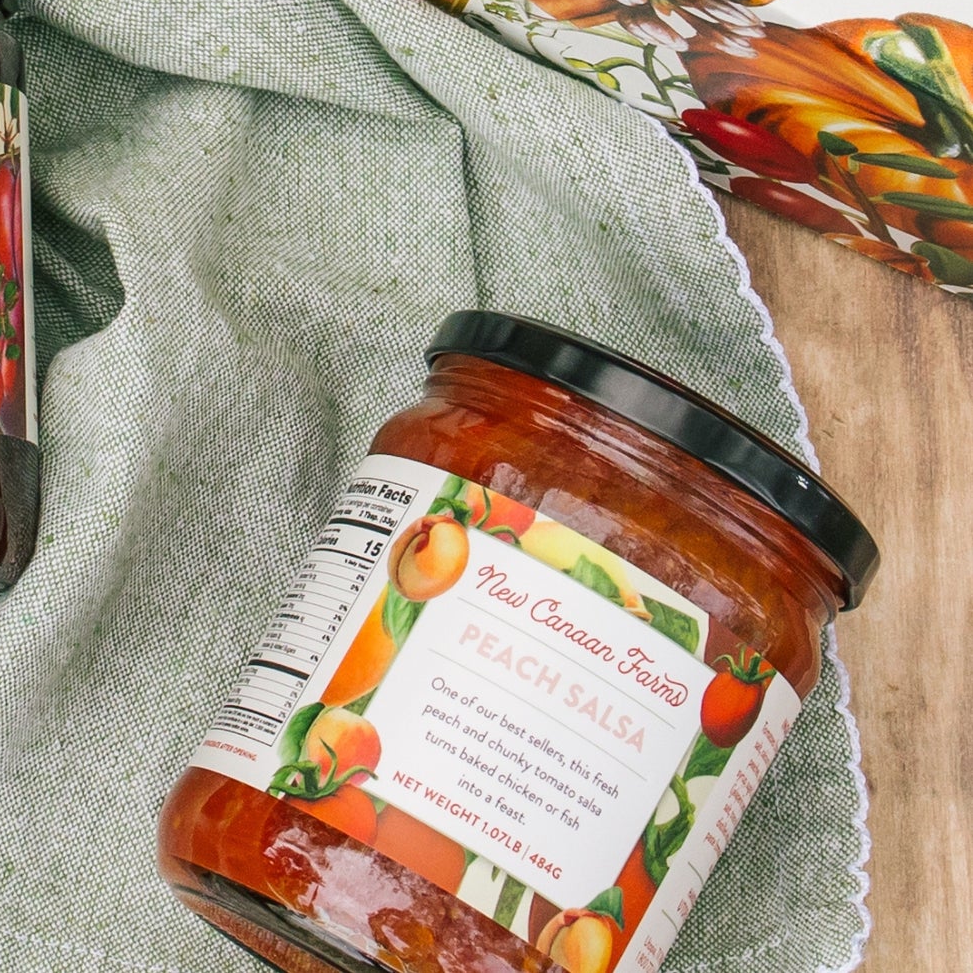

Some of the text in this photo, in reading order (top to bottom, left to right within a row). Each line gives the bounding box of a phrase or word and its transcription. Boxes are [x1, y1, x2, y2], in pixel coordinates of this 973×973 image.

[364, 539, 384, 557] 15
[378, 484, 412, 505] Facts
[459, 624, 644, 753] PEACH SALSA
[476, 564, 688, 707] New Canaan Farms
[422, 705, 602, 816] peach and chunky tomato salsa
[425, 731, 579, 831] turns baked chicken or fish
[431, 677, 618, 799] One of our best sellers, this fresh
[392, 771, 562, 880] NET WEIGHT 1.07LB 484G
[457, 774, 525, 825] into a feast.
